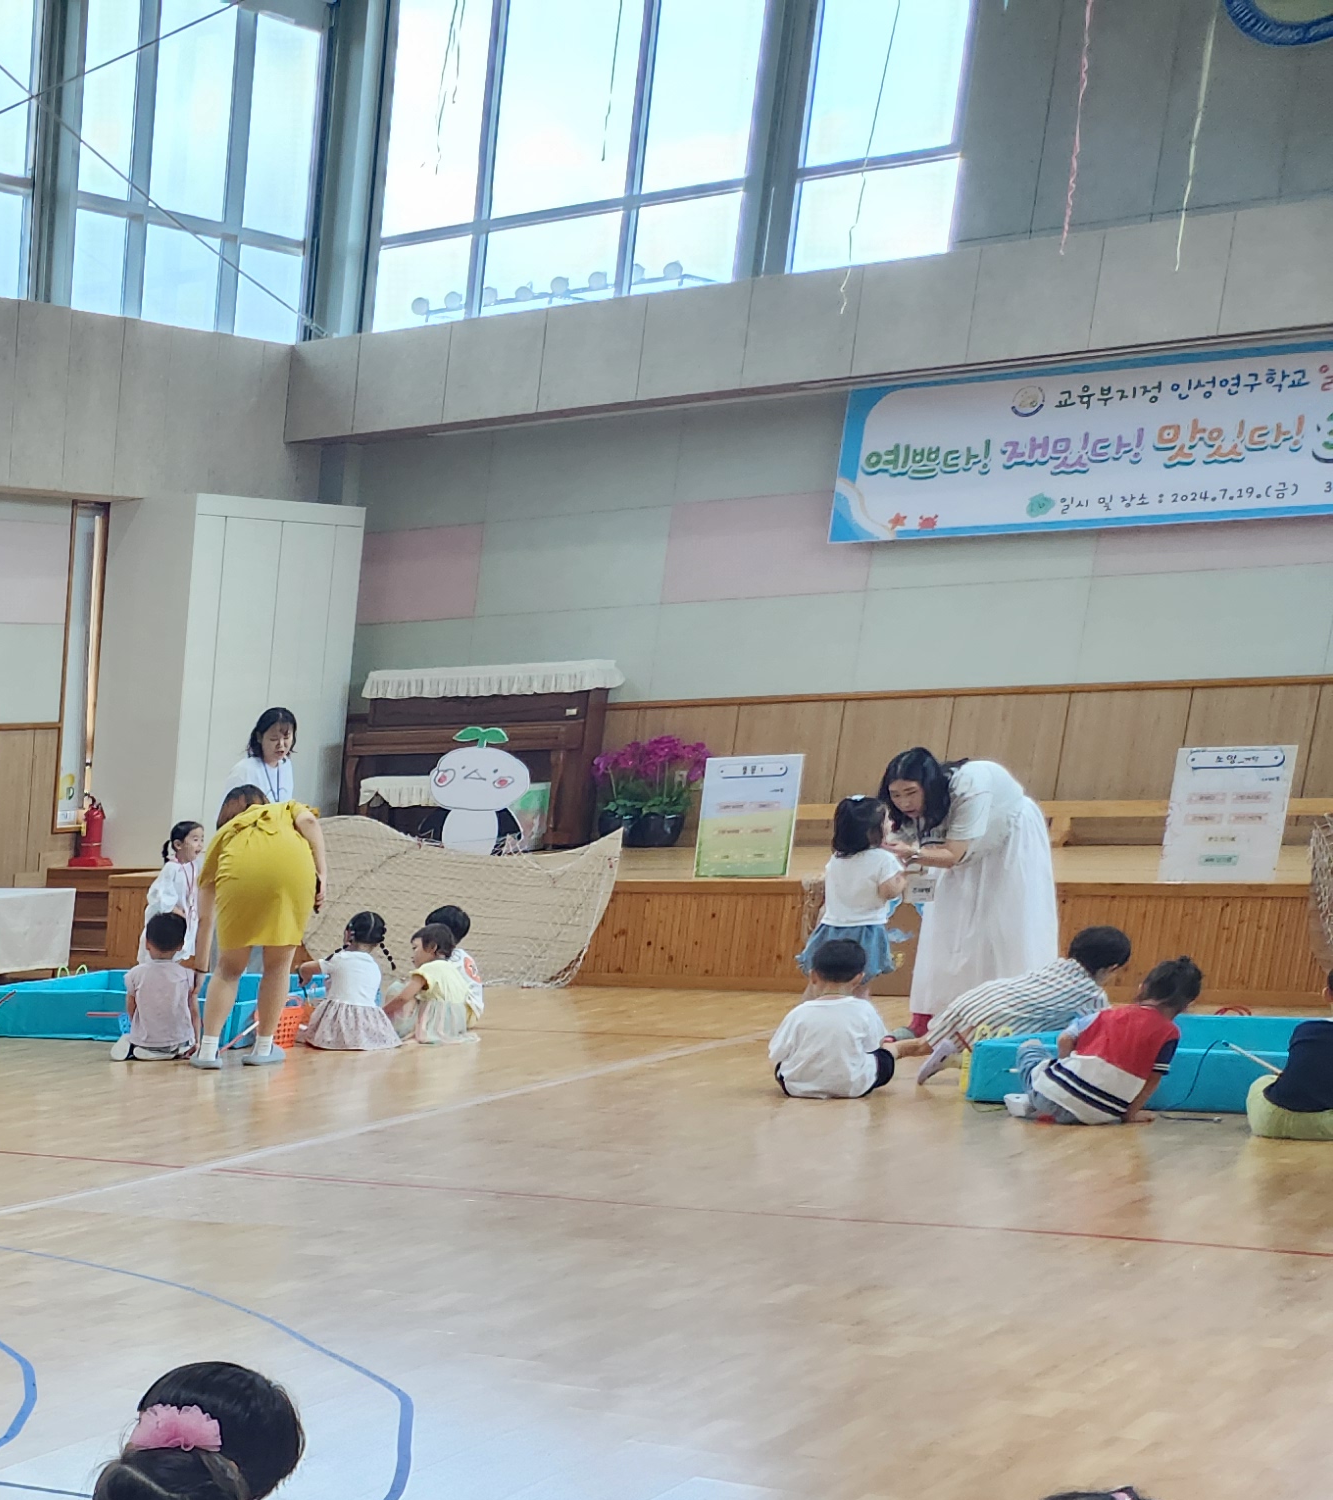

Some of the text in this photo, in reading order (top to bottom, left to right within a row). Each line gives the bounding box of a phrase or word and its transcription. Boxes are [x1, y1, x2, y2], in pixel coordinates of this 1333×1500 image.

[1054, 381, 1163, 409] 교육부지정
[1170, 368, 1311, 400] 인성연구학교
[863, 438, 991, 478] 예쁘다!
[1002, 427, 1145, 474] 재밌다!
[1153, 414, 1305, 468] 맛있다!
[1059, 496, 1089, 514] 일시
[1097, 494, 1113, 511] 및
[1120, 493, 1150, 508] 장소
